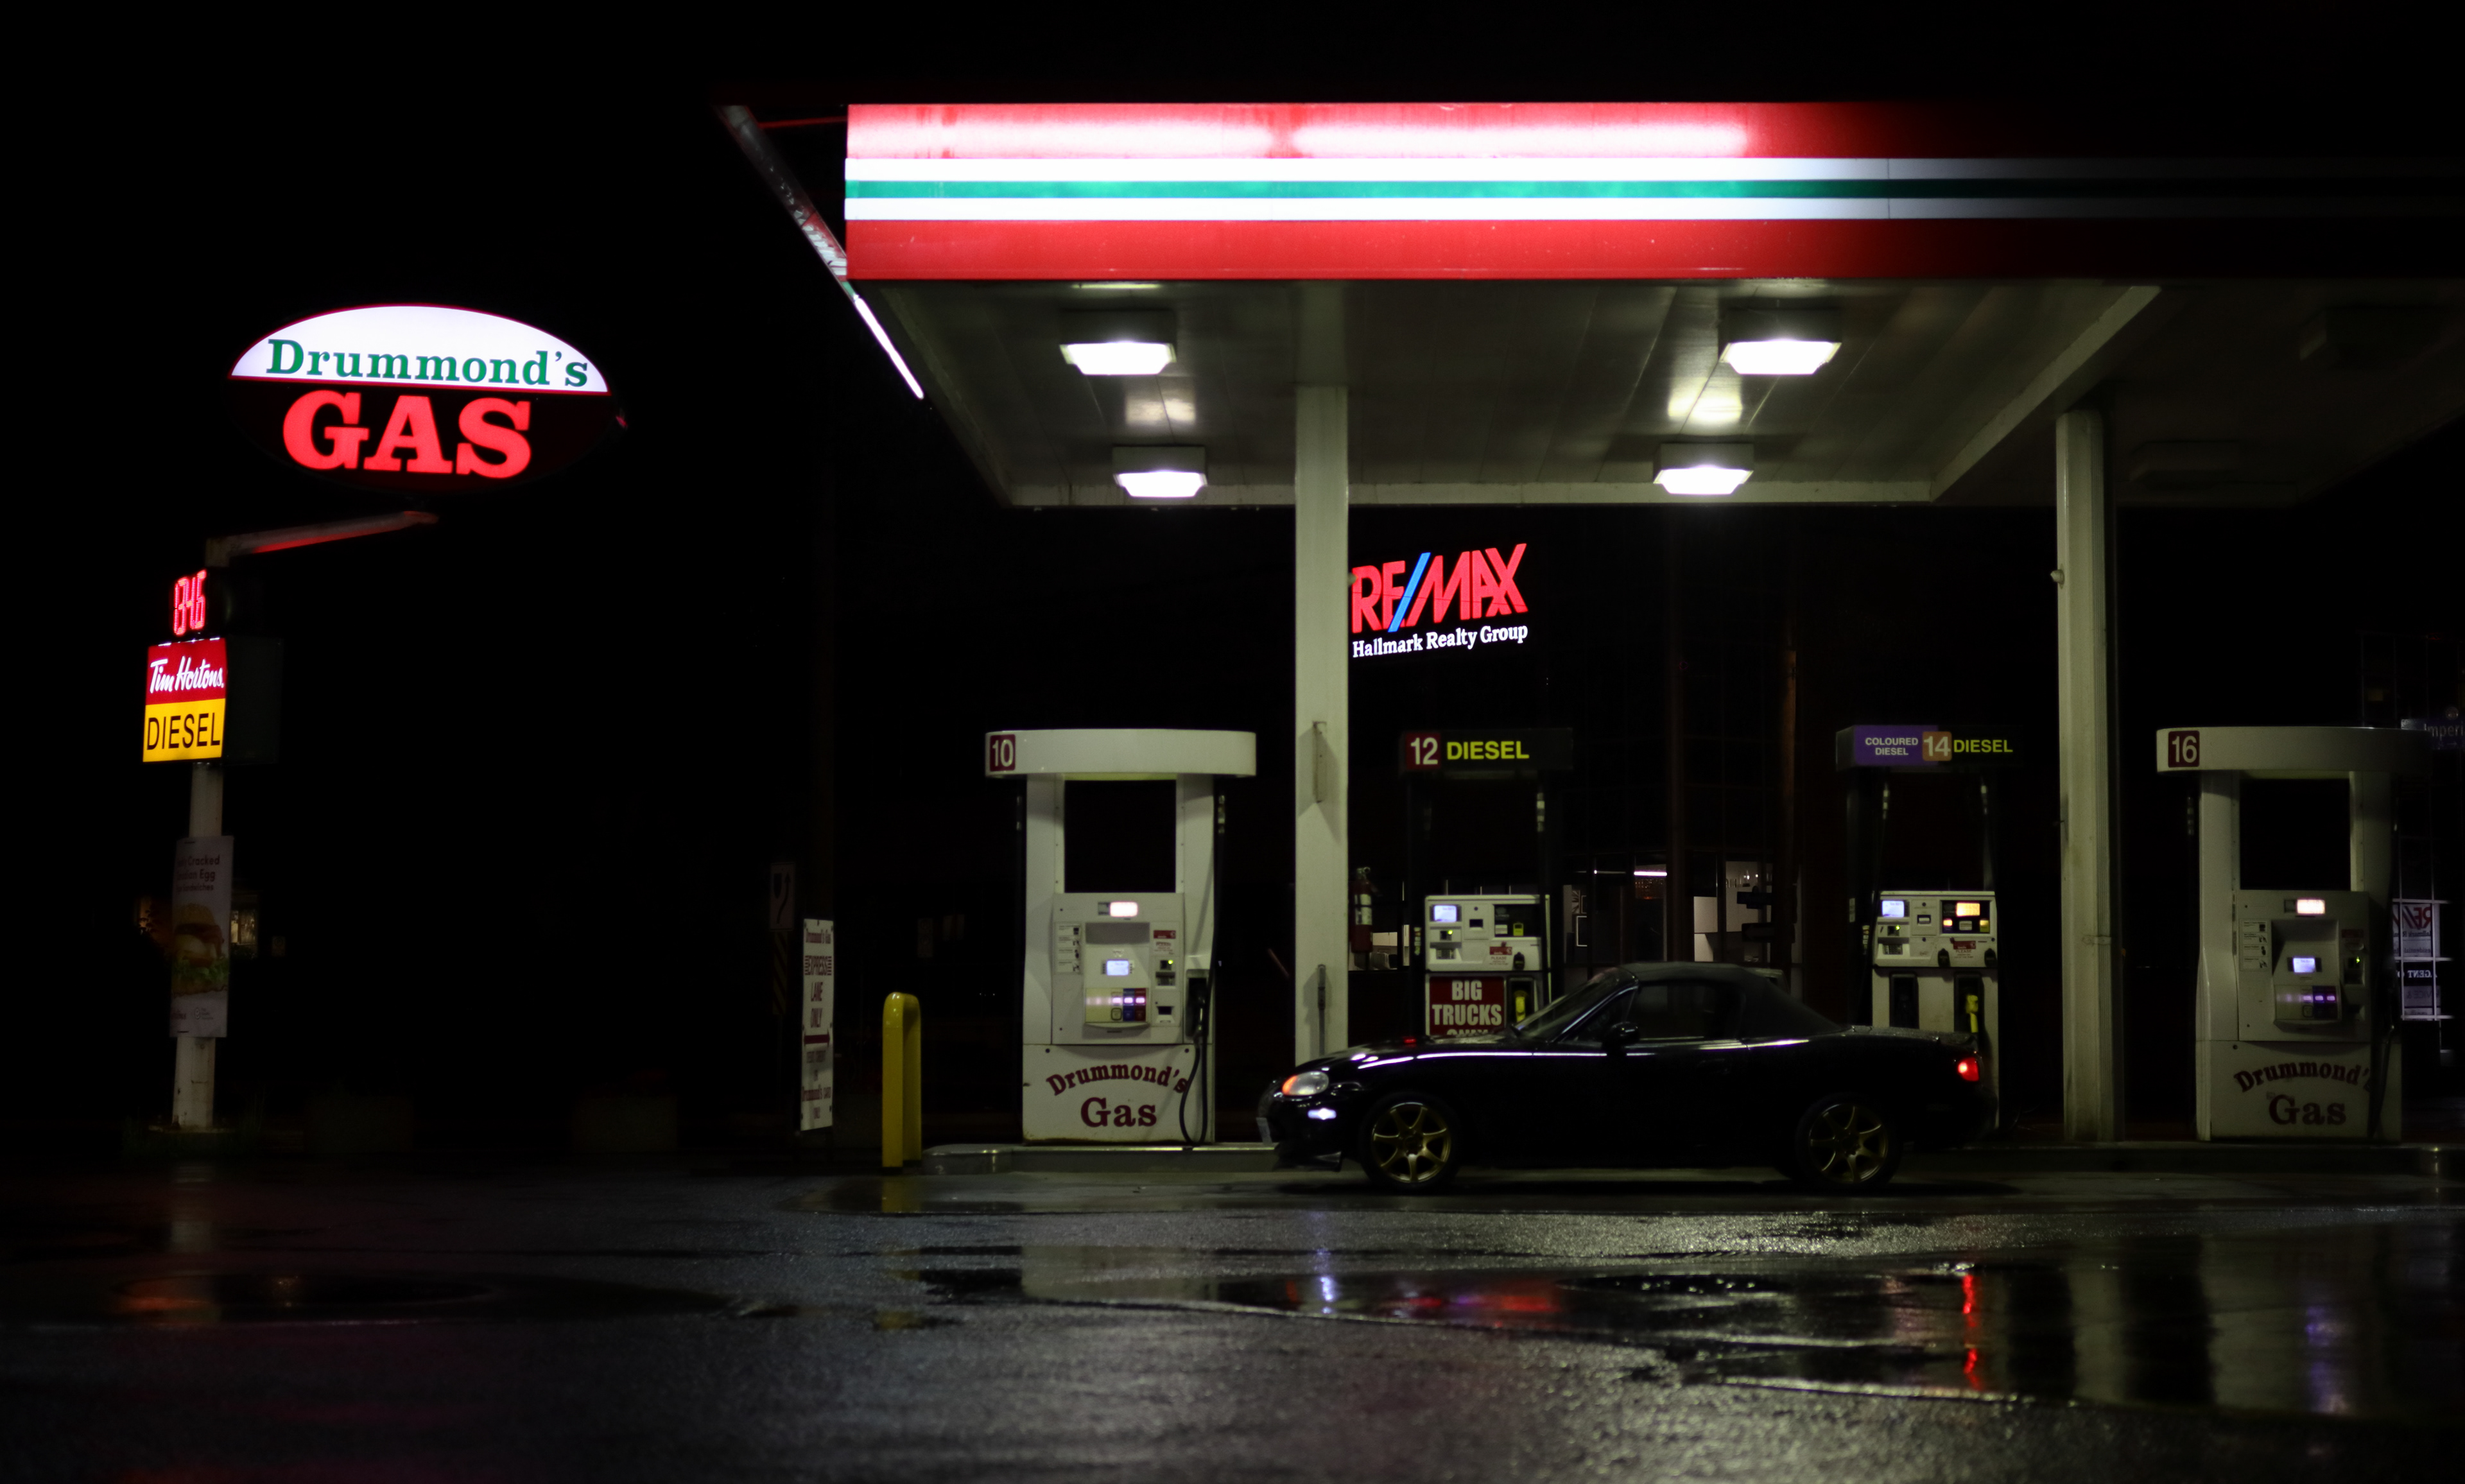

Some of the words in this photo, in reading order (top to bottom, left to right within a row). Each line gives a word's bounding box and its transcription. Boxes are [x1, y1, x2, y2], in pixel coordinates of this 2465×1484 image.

[266, 338, 589, 387] Drummond's
[283, 390, 532, 479] GAS
[1351, 543, 1528, 634] RE/MAX
[1353, 634, 1423, 657] Hallmark
[1426, 628, 1477, 650] Realty
[1480, 625, 1528, 644] Group
[150, 658, 175, 693] Tim
[146, 712, 220, 750] DIESEL
[1865, 737, 1919, 746] COLOURED
[2424, 720, 2465, 741] Imperi
[991, 738, 1015, 767] 10
[1410, 738, 1439, 765] 12
[1447, 741, 1530, 760] DIESEL
[1874, 746, 1909, 756] DIESEL
[1923, 736, 1950, 757] 14
[1953, 739, 2014, 754] DIESEL
[2171, 735, 2199, 764] 16
[187, 854, 220, 867] Cracked
[200, 868, 216, 882] Egg
[1451, 979, 1483, 1001] BIG
[1431, 1003, 1502, 1026] TRUCKS
[1046, 1063, 1188, 1096] Drummond's
[1080, 1096, 1157, 1127] Gas
[2269, 1094, 2347, 1125] Gas
